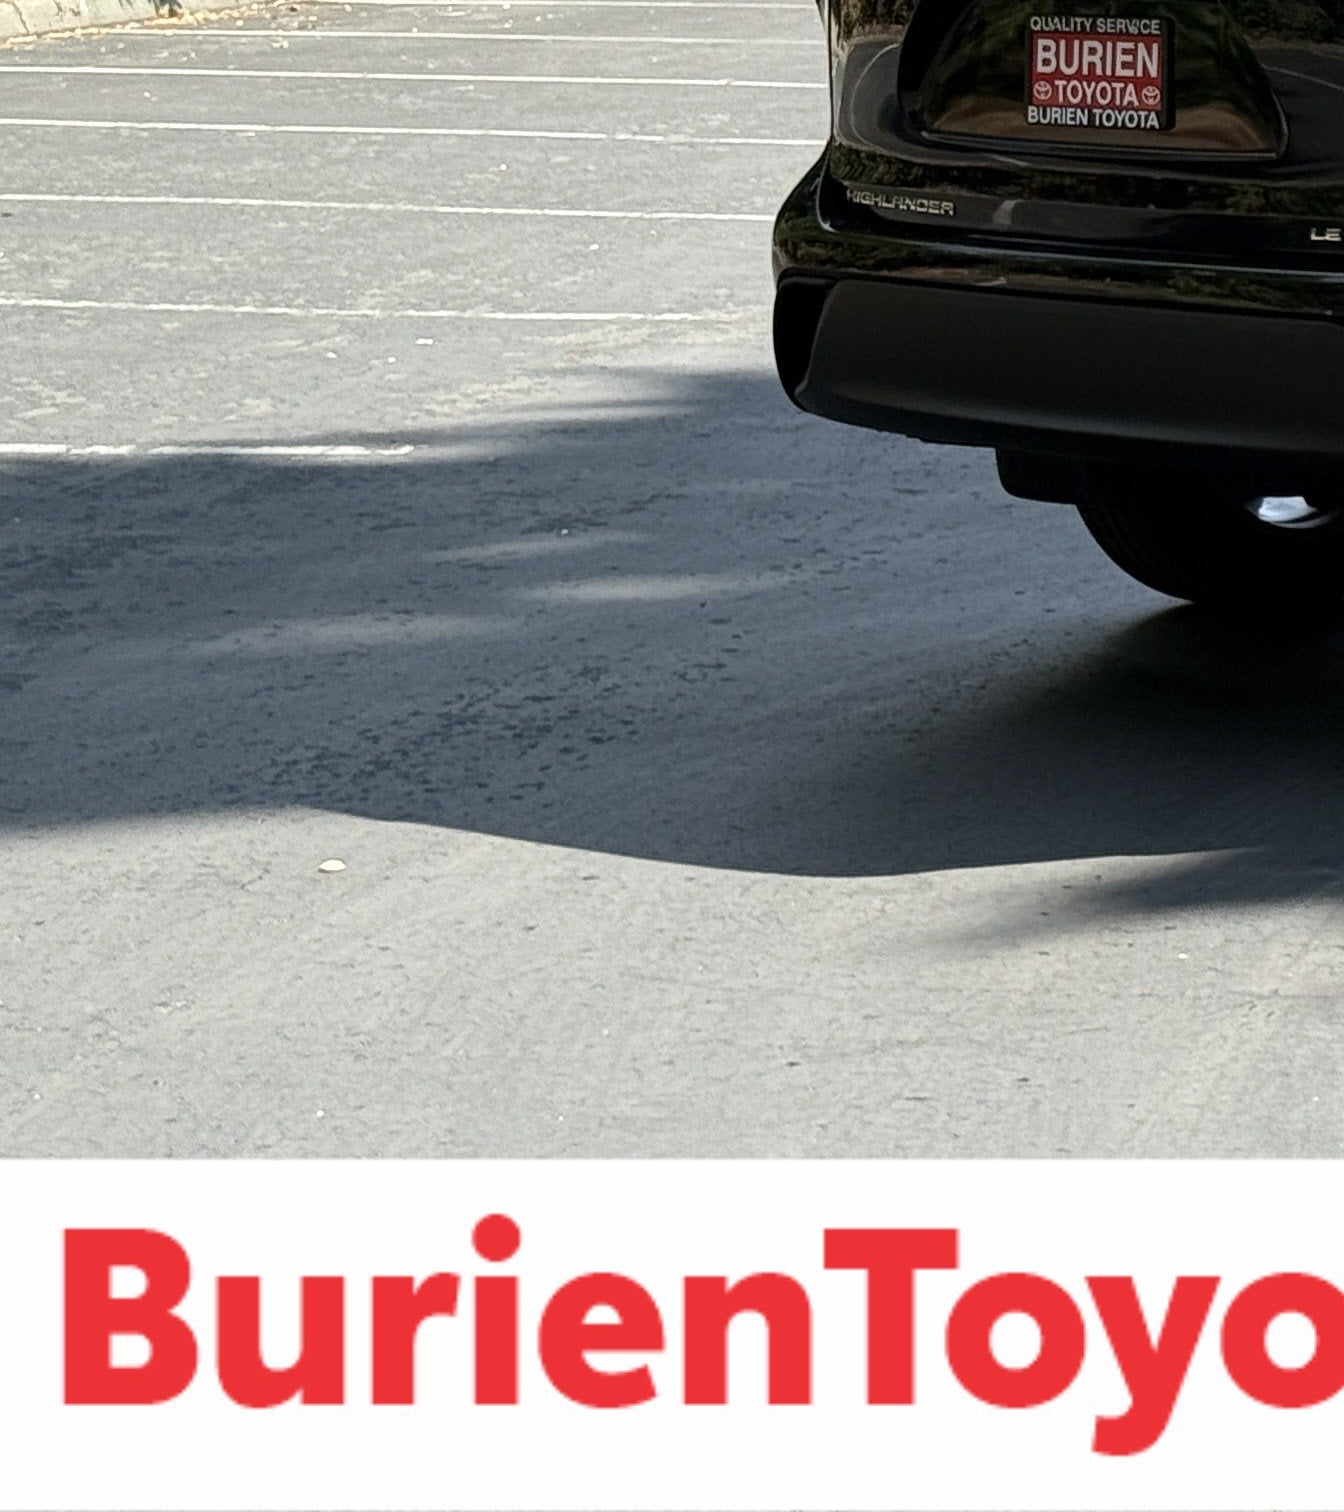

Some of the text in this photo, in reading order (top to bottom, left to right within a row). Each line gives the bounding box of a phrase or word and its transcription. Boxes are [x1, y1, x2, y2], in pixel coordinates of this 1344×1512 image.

[1030, 16, 1161, 35] QUALITY SERVICE
[1036, 38, 1159, 78] BURIEN
[1054, 79, 1140, 107] TOYOTA
[1027, 105, 1160, 129] BURIEN TOYOTA
[846, 188, 954, 217] HIGHLANDER
[1310, 227, 1342, 242] LE
